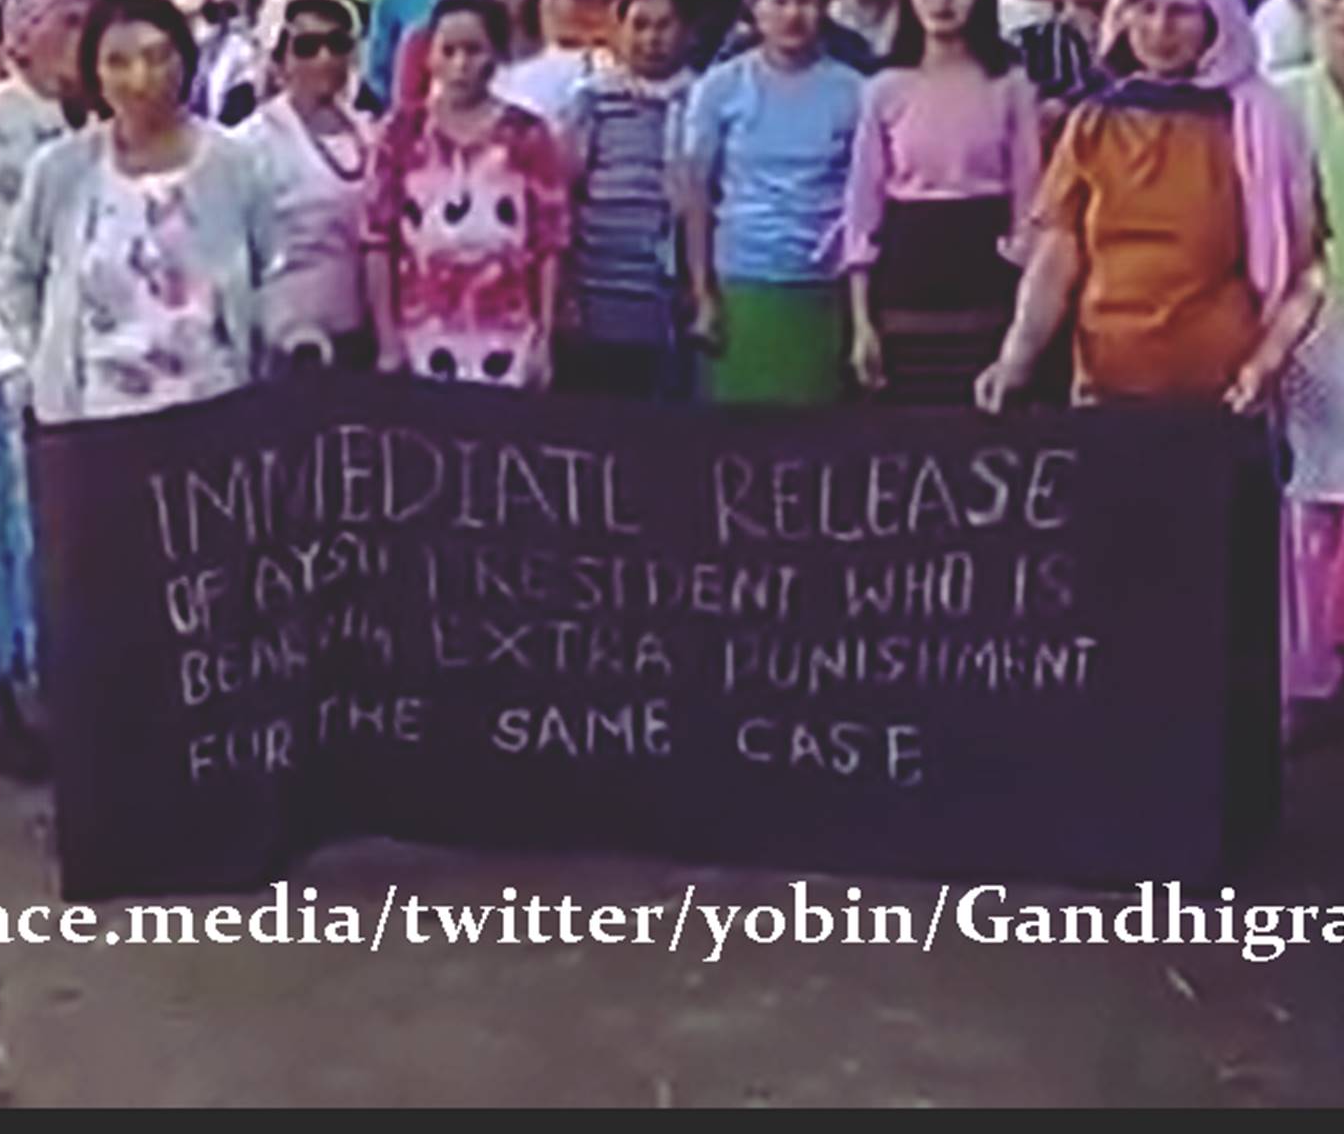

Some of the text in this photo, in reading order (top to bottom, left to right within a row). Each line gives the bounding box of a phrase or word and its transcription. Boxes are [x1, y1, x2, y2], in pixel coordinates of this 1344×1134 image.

[711, 446, 1079, 547] RELEASE
[165, 568, 228, 637] OF
[844, 551, 975, 618] WHO
[1013, 550, 1076, 617] IS
[429, 612, 673, 675] EXTRA
[721, 632, 1099, 697] PUNISHMENT
[317, 692, 430, 745] THE
[491, 698, 673, 757] SAME
[735, 716, 924, 786] CASE
